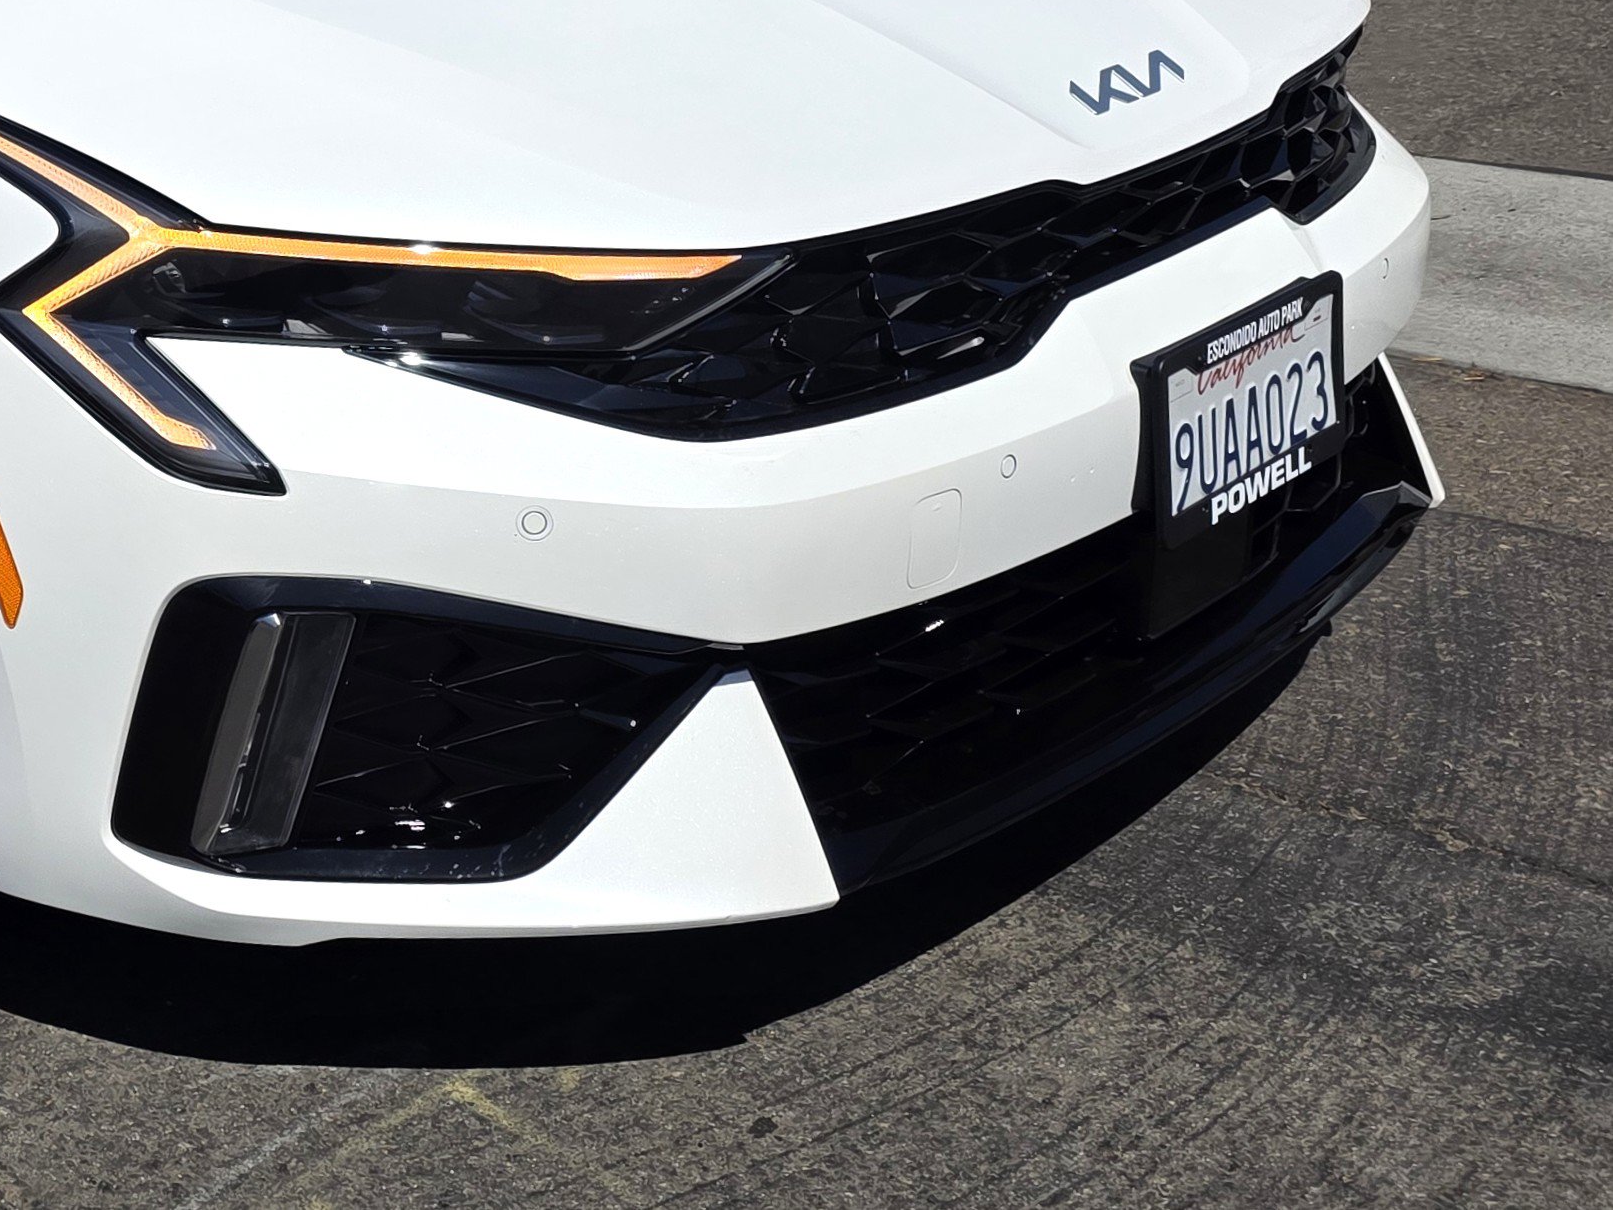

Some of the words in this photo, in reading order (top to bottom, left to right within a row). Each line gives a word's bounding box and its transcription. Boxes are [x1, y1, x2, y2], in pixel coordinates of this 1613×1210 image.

[1069, 49, 1185, 116] KIA
[1207, 320, 1257, 364] ESCONDIDO
[1257, 308, 1280, 339] AUTO
[1281, 297, 1304, 329] PARK
[1174, 351, 1329, 513] 9UAA023
[1211, 446, 1312, 525] POWELL
